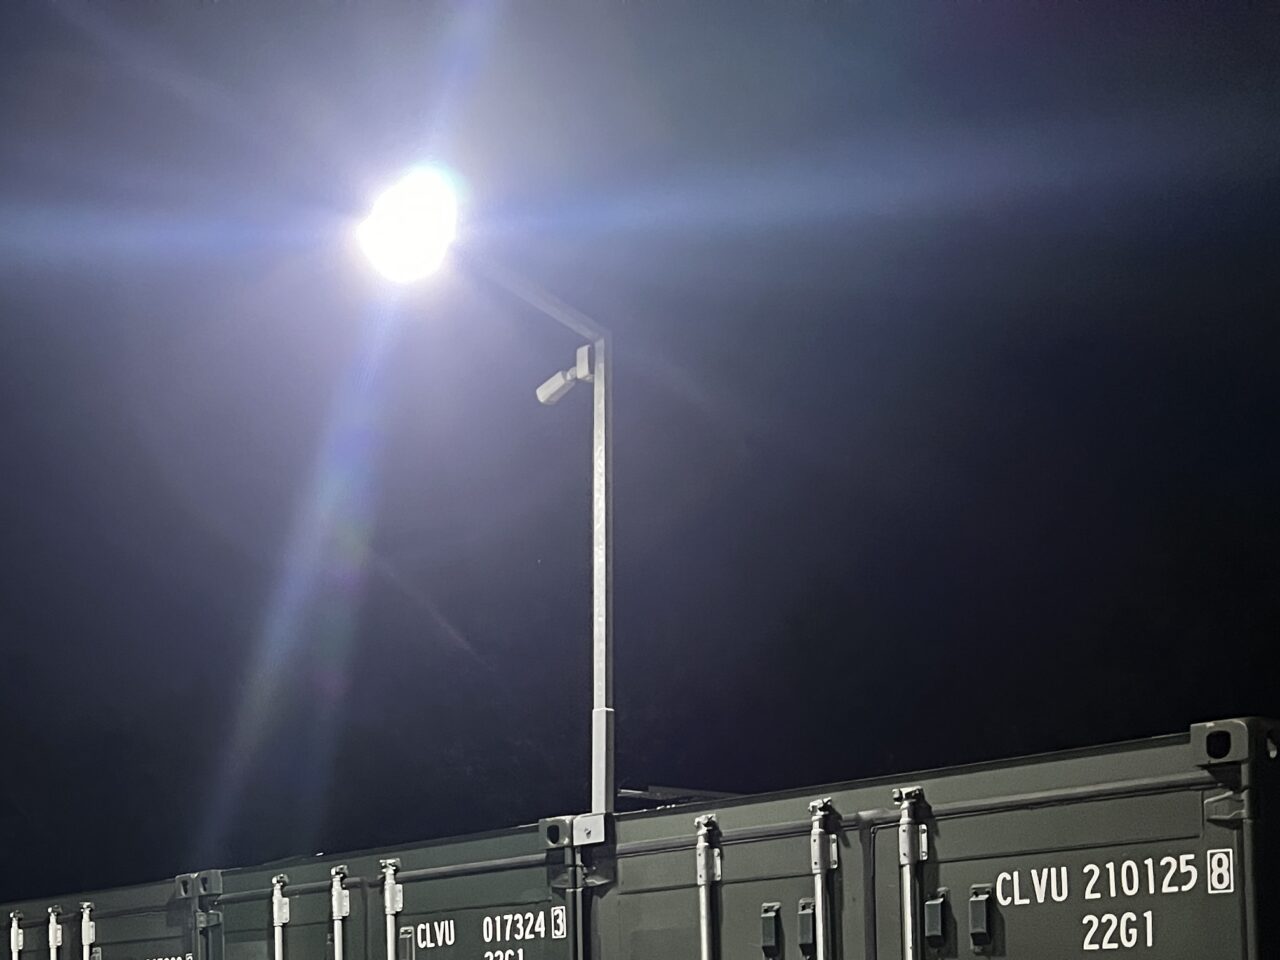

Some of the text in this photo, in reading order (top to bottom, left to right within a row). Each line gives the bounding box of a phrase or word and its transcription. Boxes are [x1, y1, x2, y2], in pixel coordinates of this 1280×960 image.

[995, 851, 1232, 906] CLVU 210125 8
[417, 907, 566, 949] CLVU 017324 3
[1082, 910, 1153, 950] 22G1
